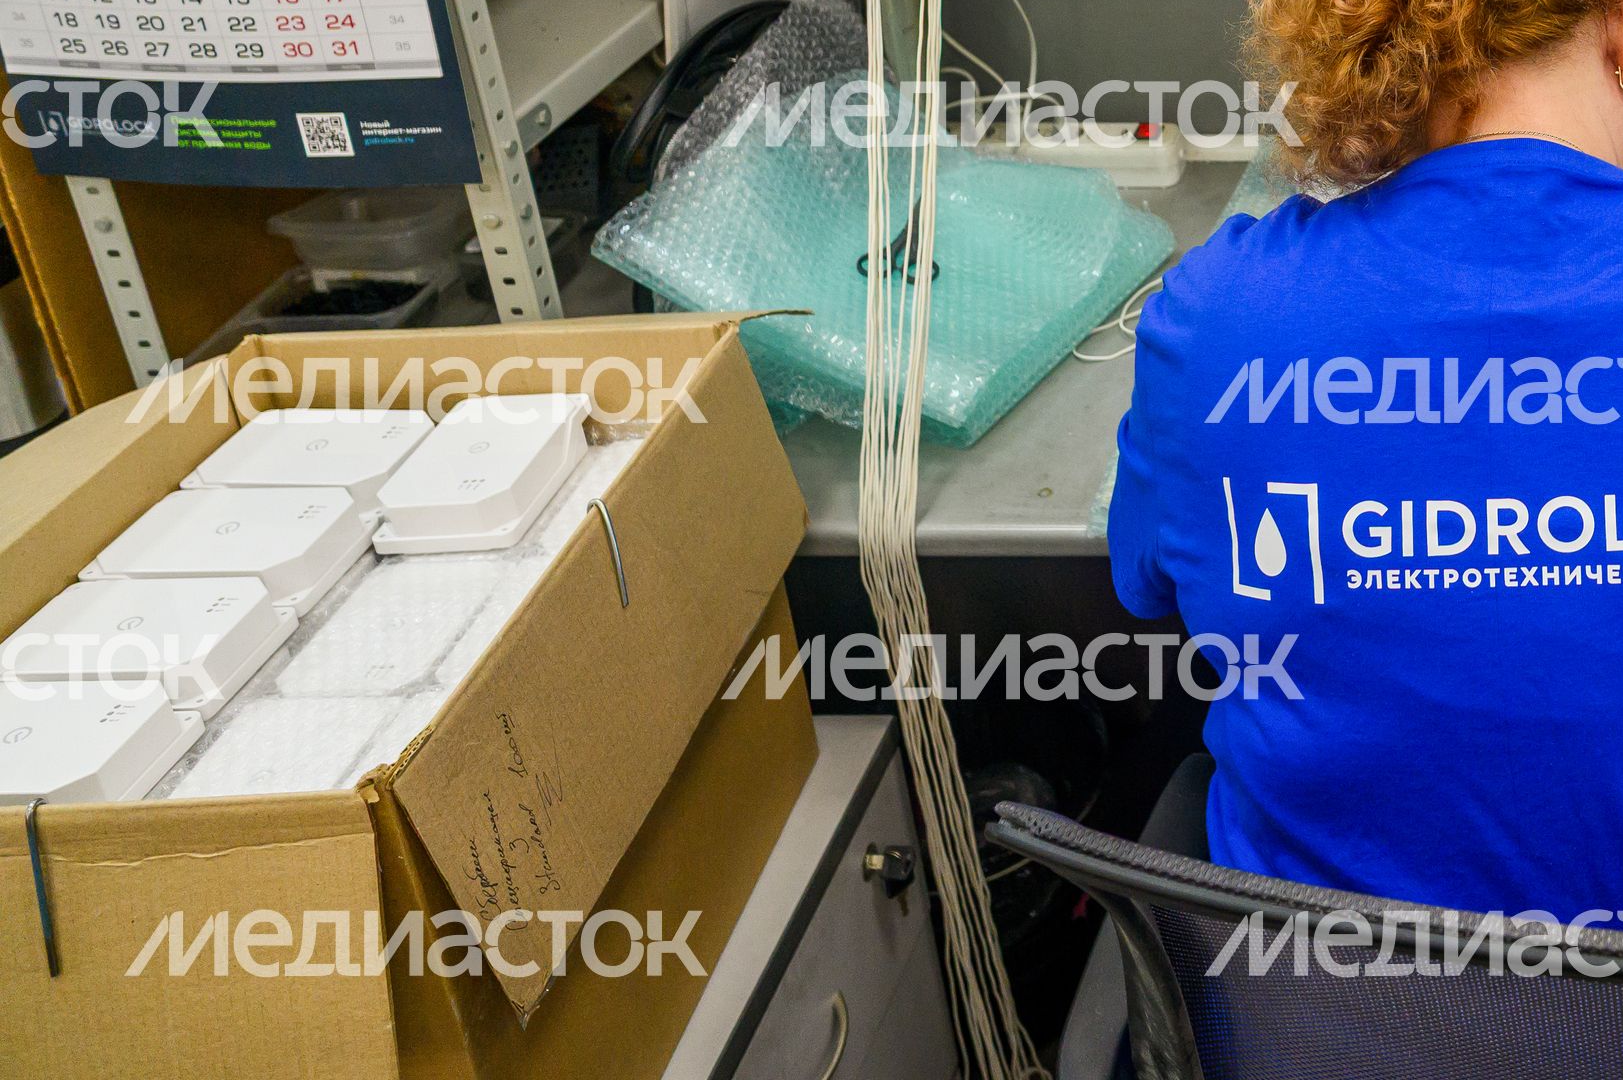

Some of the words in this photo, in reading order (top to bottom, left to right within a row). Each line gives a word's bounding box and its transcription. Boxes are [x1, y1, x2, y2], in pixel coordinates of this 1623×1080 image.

[54, 12, 78, 27] 18
[96, 14, 120, 29] 19
[137, 16, 164, 31] 20
[181, 17, 206, 31] 21
[228, 17, 257, 32] 22
[276, 16, 305, 31] 23
[325, 14, 355, 30] 24
[60, 38, 86, 54] 25
[102, 40, 128, 56] 26
[145, 42, 169, 57] 27
[189, 43, 217, 58] 28
[235, 43, 263, 58] 29
[283, 42, 313, 57] 30
[332, 41, 358, 56] 31
